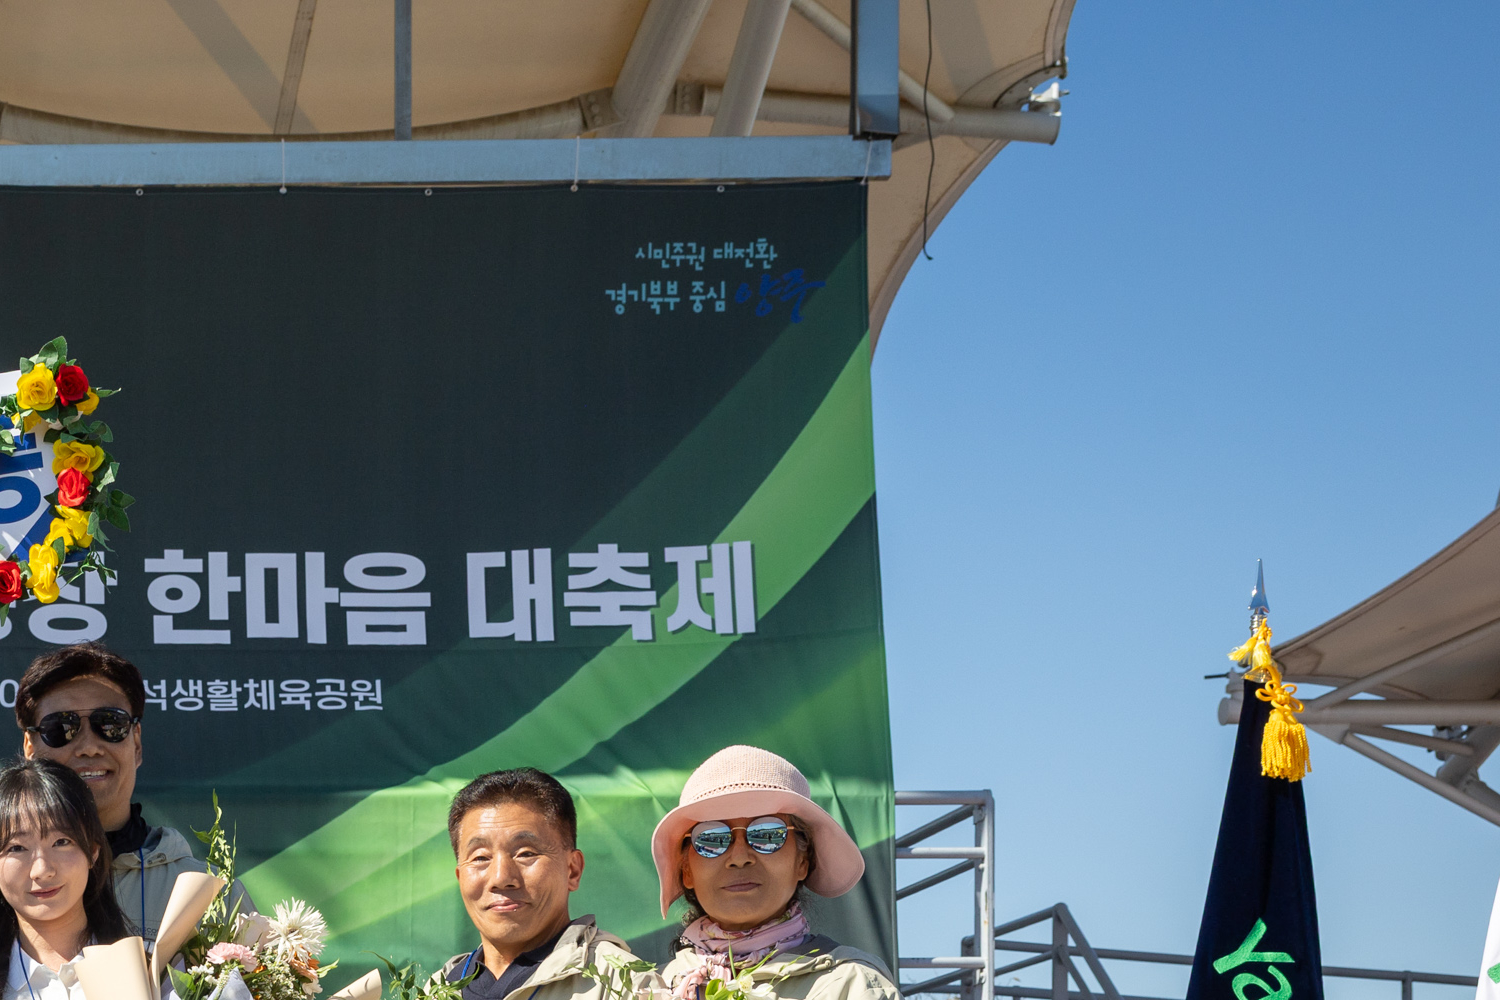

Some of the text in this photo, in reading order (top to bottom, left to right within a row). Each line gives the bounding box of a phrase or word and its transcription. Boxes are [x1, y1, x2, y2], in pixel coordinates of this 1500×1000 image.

[635, 238, 778, 271] 시민주권 대전환
[605, 268, 826, 324] 경기북부 중심 양주
[144, 549, 432, 646] 한마음
[466, 540, 757, 643] 대축제
